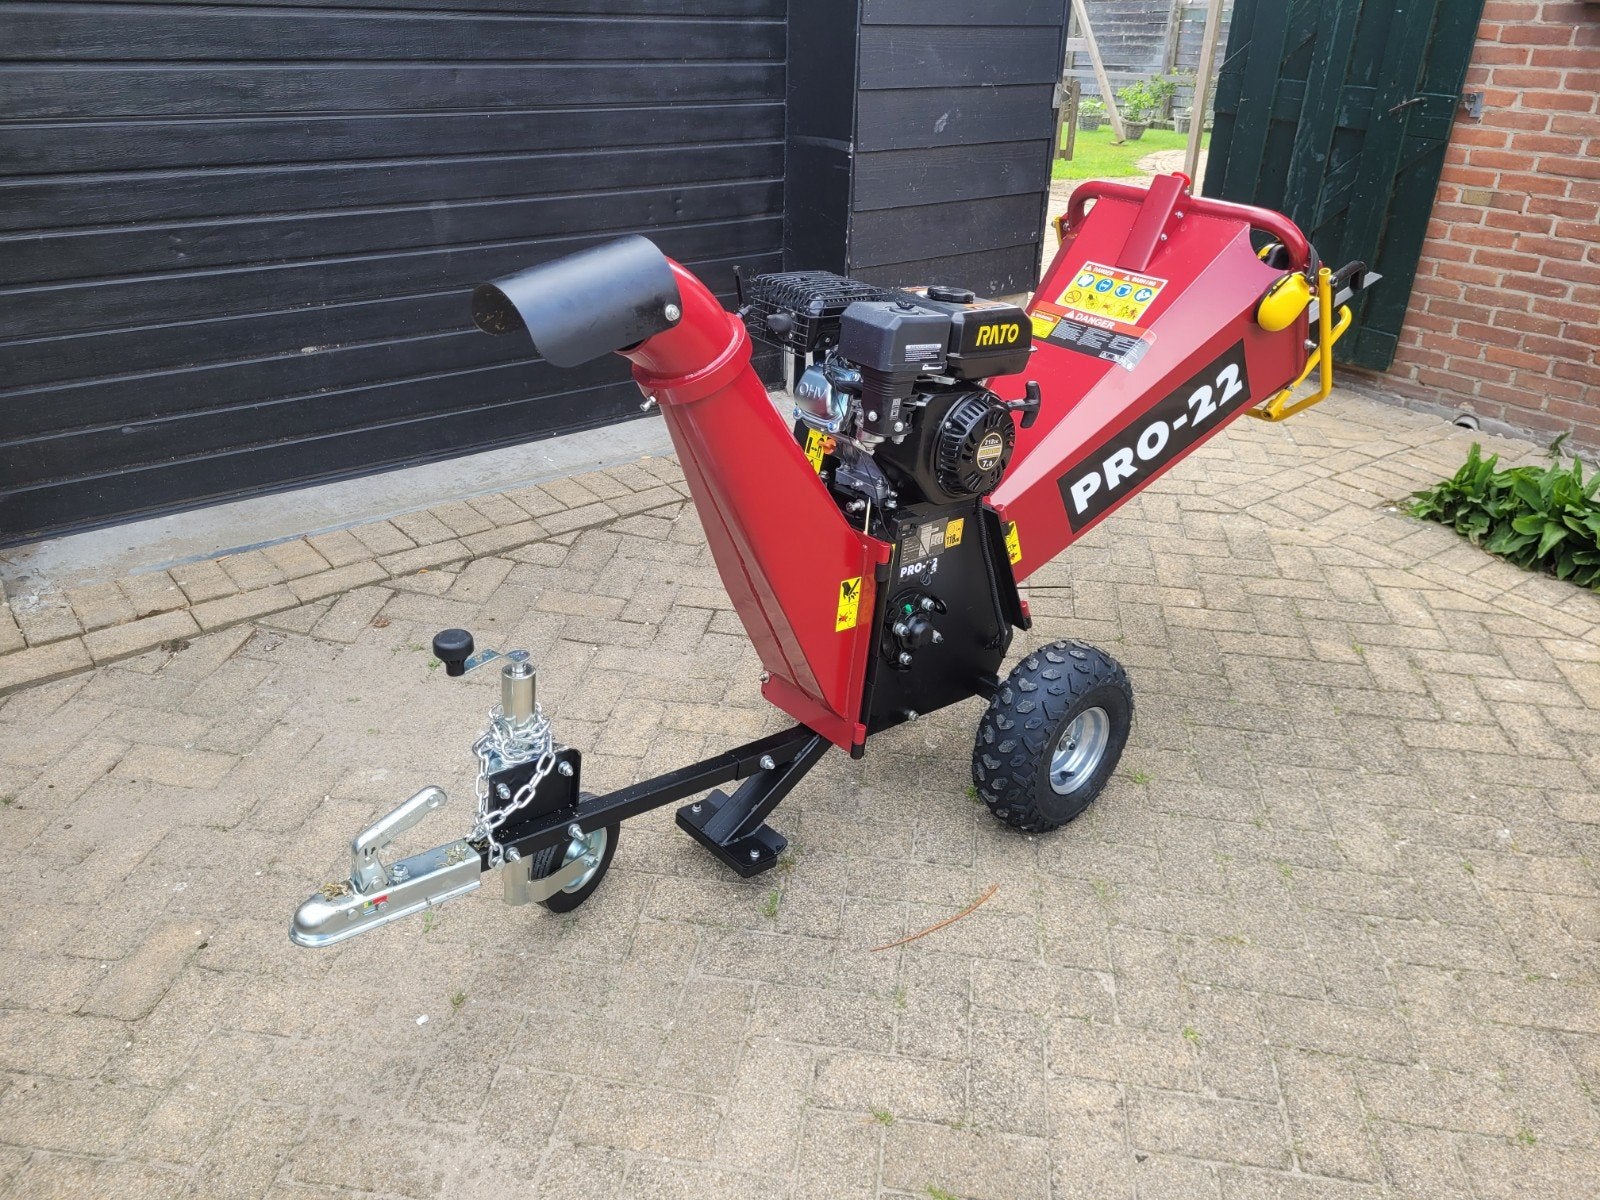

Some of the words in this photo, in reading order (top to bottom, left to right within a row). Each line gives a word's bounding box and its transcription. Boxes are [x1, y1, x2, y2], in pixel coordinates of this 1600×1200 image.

[1075, 313, 1116, 329] DANGER
[975, 323, 1019, 346] RATO
[1070, 363, 1243, 515] PRO-22
[899, 557, 938, 578] PRO-2
